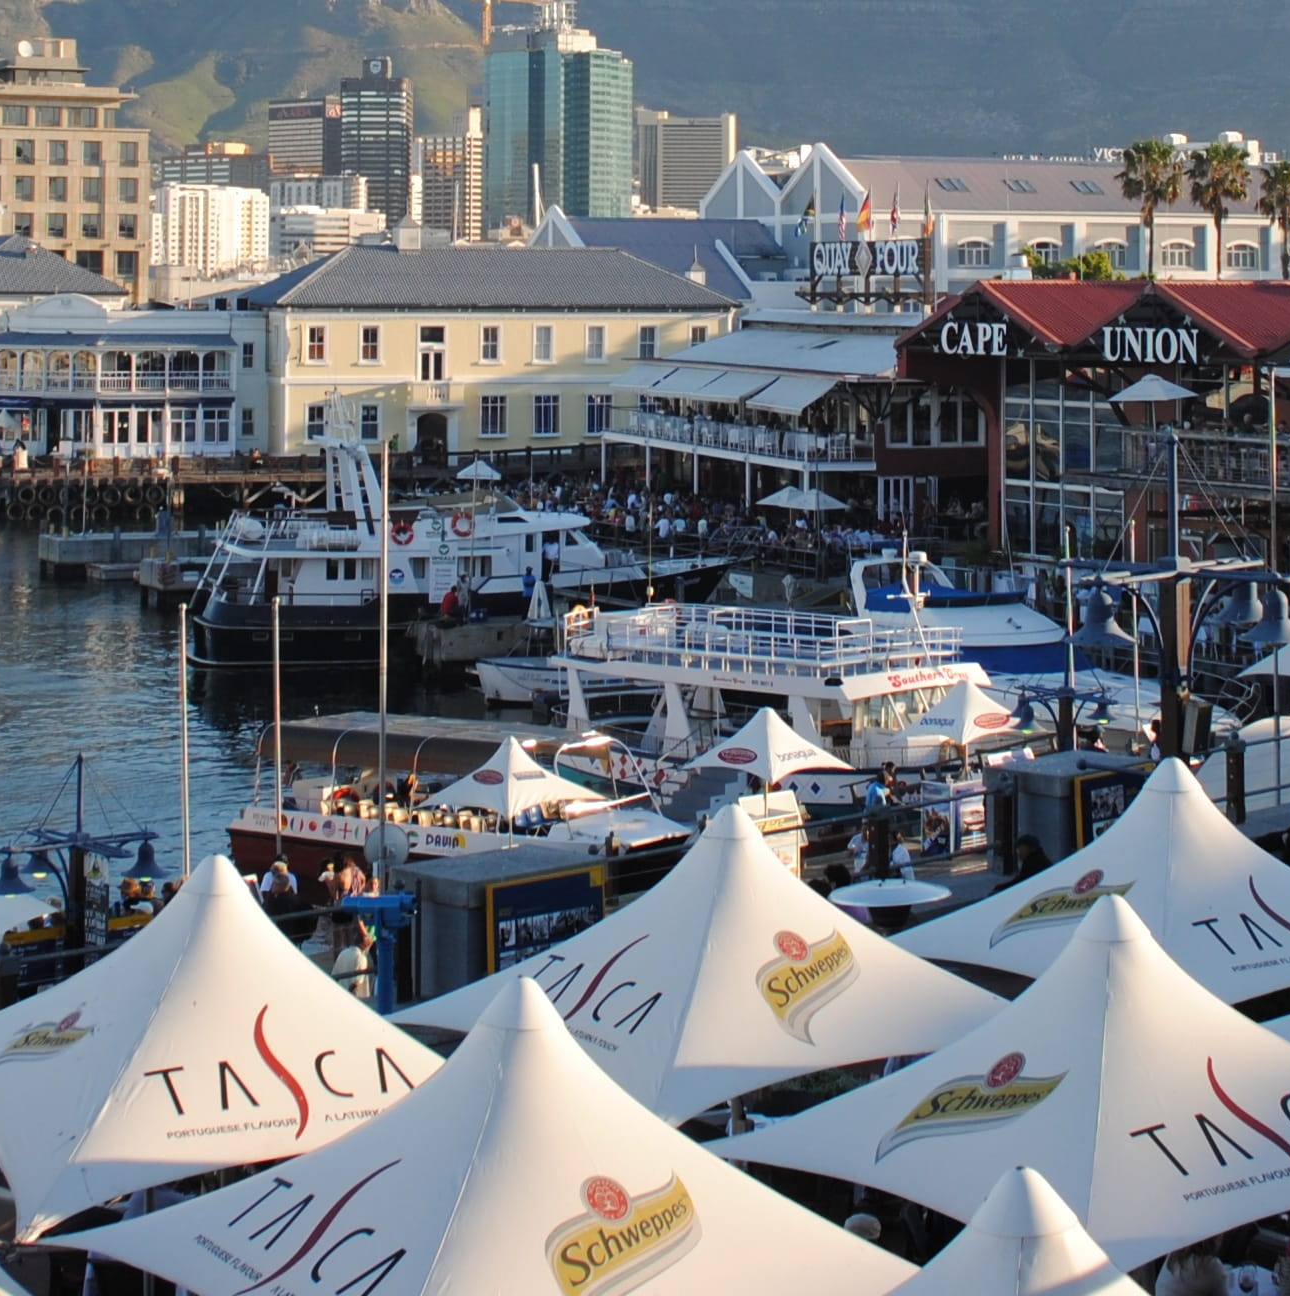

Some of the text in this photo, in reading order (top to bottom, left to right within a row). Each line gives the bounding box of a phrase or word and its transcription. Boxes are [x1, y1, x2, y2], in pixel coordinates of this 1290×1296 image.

[814, 241, 918, 276] QUAY FOUR
[941, 322, 1007, 356] CAPE
[1103, 326, 1198, 364] UNION
[533, 934, 663, 1034] TASCA
[767, 947, 848, 1008] Schweppes
[144, 1004, 414, 1140] TASCA
[335, 1108, 387, 1120] LATURK
[914, 1088, 1043, 1120] Schweppes
[166, 1117, 298, 1140] PORTUGUESE FLAVOUR
[1183, 1179, 1249, 1202] PORTUGUESE
[228, 1158, 407, 1296] TASCA
[561, 1198, 687, 1287] Schweppes
